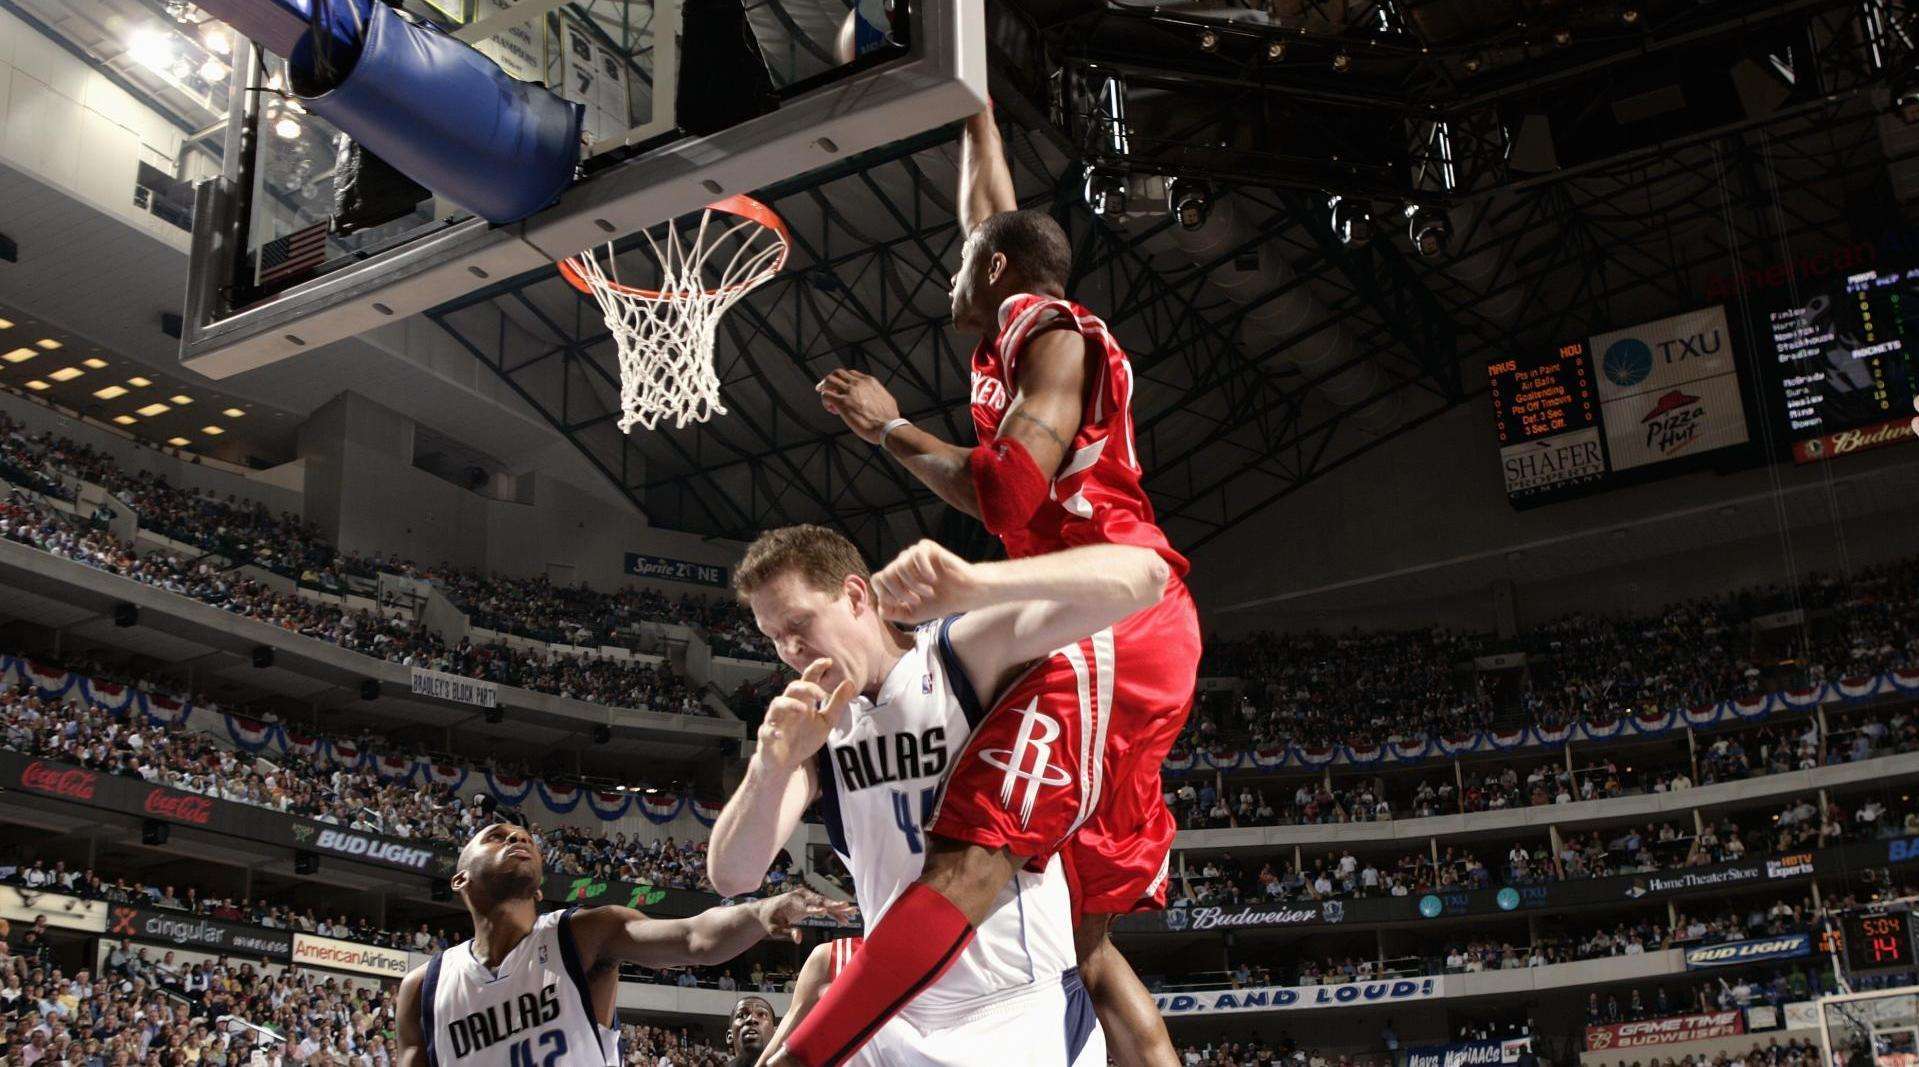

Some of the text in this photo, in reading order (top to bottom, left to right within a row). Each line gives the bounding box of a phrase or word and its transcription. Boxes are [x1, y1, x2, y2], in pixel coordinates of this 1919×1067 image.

[576, 71, 590, 95] 7
[1560, 344, 1583, 360] HOU
[1656, 330, 1721, 364] TXU
[1515, 370, 1529, 382] Pts
[1530, 370, 1539, 379] in
[1539, 362, 1561, 375] Paint
[1522, 381, 1534, 391] Air
[1534, 375, 1556, 388] Balls
[1515, 385, 1565, 403] Goaltending
[1512, 405, 1525, 416] Pts
[1526, 401, 1540, 412] Off
[1646, 407, 1704, 448] Pizza
[1659, 423, 1697, 451] Hut
[1833, 424, 1914, 454] Budwe
[1505, 441, 1601, 481] SHAFER
[633, 557, 674, 576] Sprite
[452, 681, 474, 702] BLOCK
[475, 686, 497, 707] PARTY
[835, 727, 947, 792] ALLAS
[316, 829, 434, 868] BUD LIGHT
[1782, 852, 1813, 867] HDTV
[1767, 864, 1815, 879] Experts
[145, 913, 225, 944] cingular
[1192, 904, 1317, 930] Budweiser
[1862, 918, 1901, 936] 5:04
[1690, 947, 1736, 962] BUD
[1739, 939, 1804, 956] LIGHT
[1874, 936, 1900, 961] 14
[1214, 989, 1300, 1010] AND
[1315, 979, 1437, 1003] LOUD!
[448, 984, 561, 1059] DALLAS
[1618, 1018, 1684, 1037] GAME
[1685, 1011, 1738, 1027] TIME
[510, 1028, 568, 1067] 42
[1617, 1025, 1736, 1048] BUDWEISER
